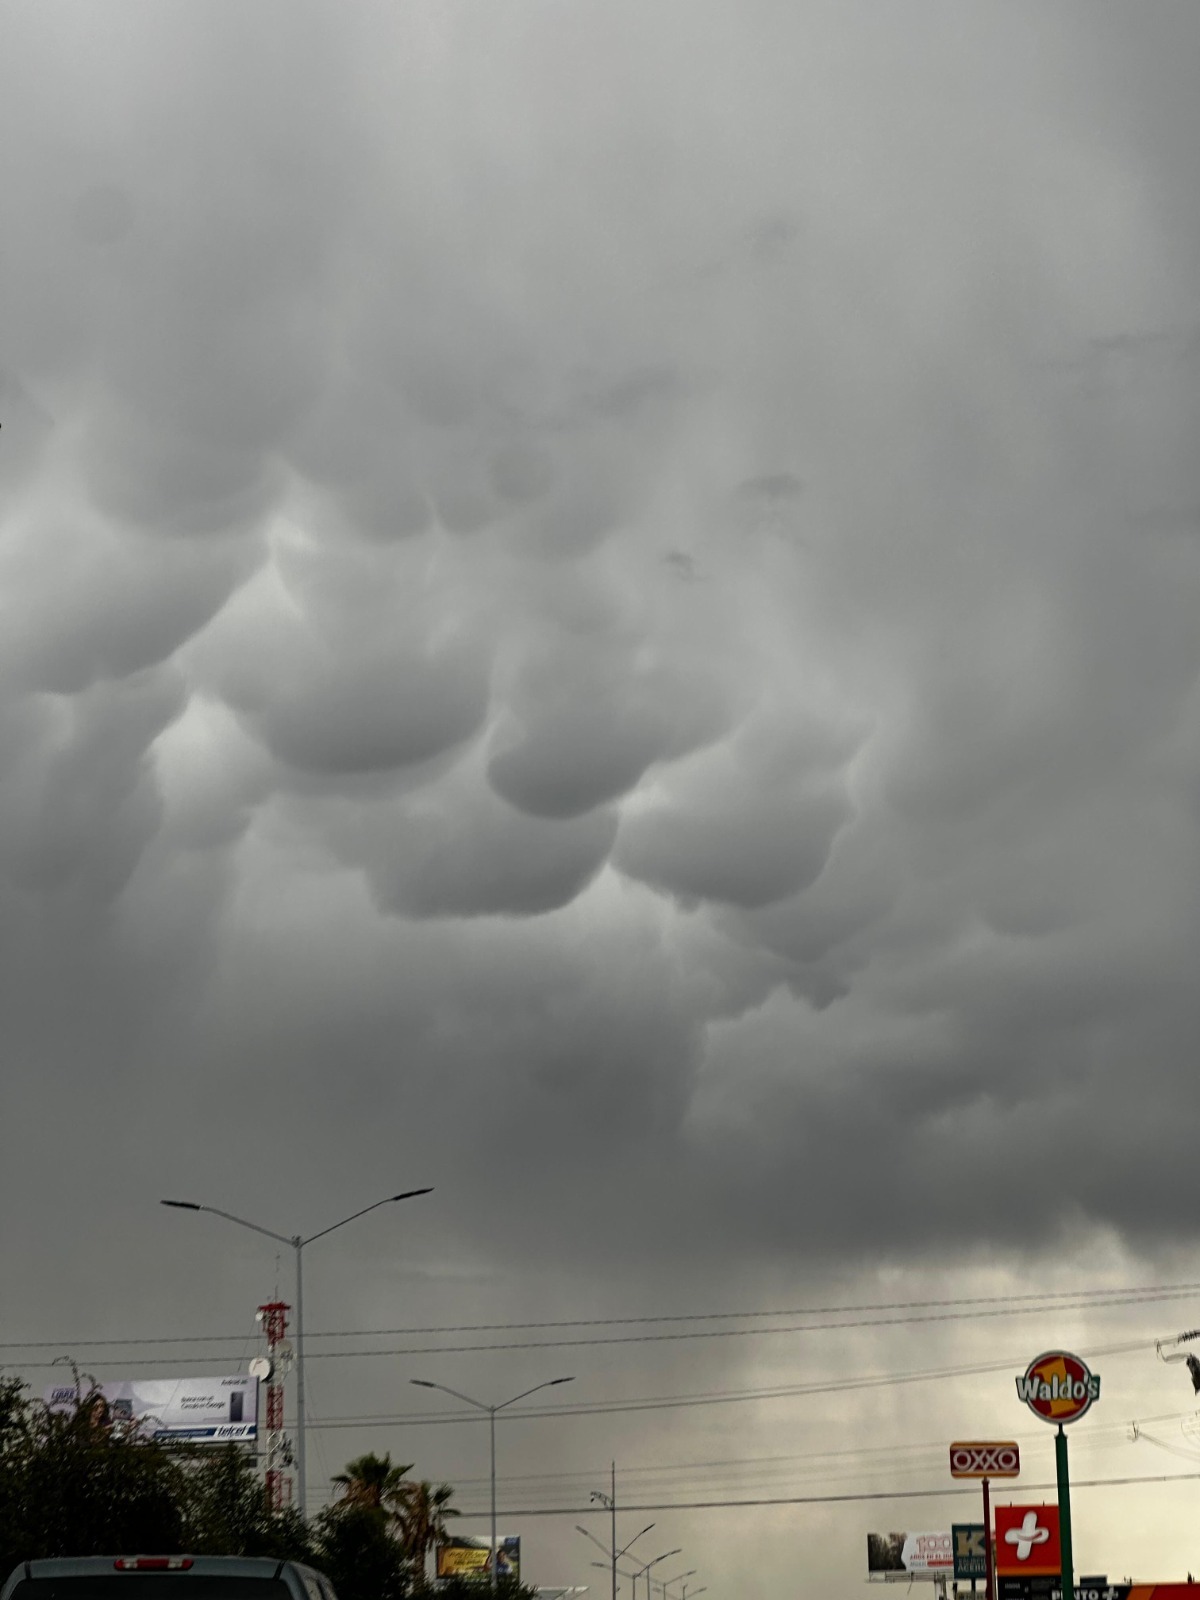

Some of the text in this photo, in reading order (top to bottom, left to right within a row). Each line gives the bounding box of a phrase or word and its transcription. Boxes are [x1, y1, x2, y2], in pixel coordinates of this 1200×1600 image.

[1017, 1374, 1098, 1401] Waldo's
[218, 1425, 247, 1437] telcel
[953, 1449, 1017, 1472] OXXO
[956, 1531, 986, 1557] K
